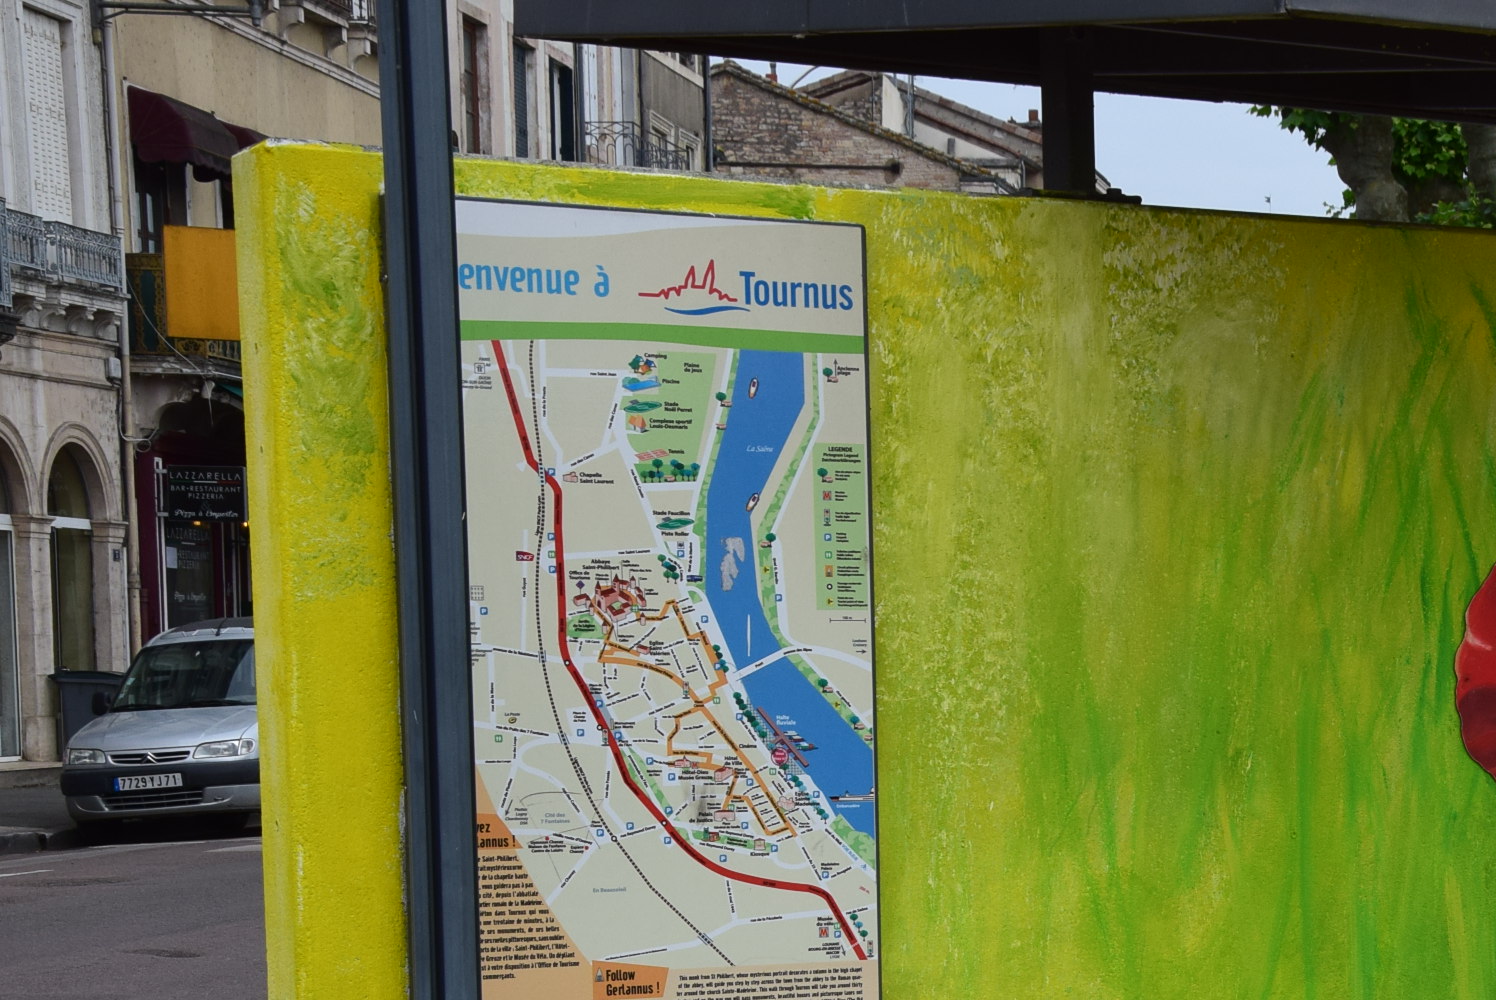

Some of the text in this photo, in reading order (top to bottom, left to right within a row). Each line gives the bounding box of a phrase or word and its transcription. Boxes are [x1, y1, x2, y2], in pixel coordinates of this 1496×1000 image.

[458, 262, 610, 298] envenue à
[738, 270, 854, 311] Tournus
[169, 471, 241, 480] LAZZARELLA
[187, 492, 224, 500] PIZZERIA
[174, 509, 196, 518] Pizza
[606, 968, 636, 982] Follow
[606, 982, 660, 996] Gerlannus !
